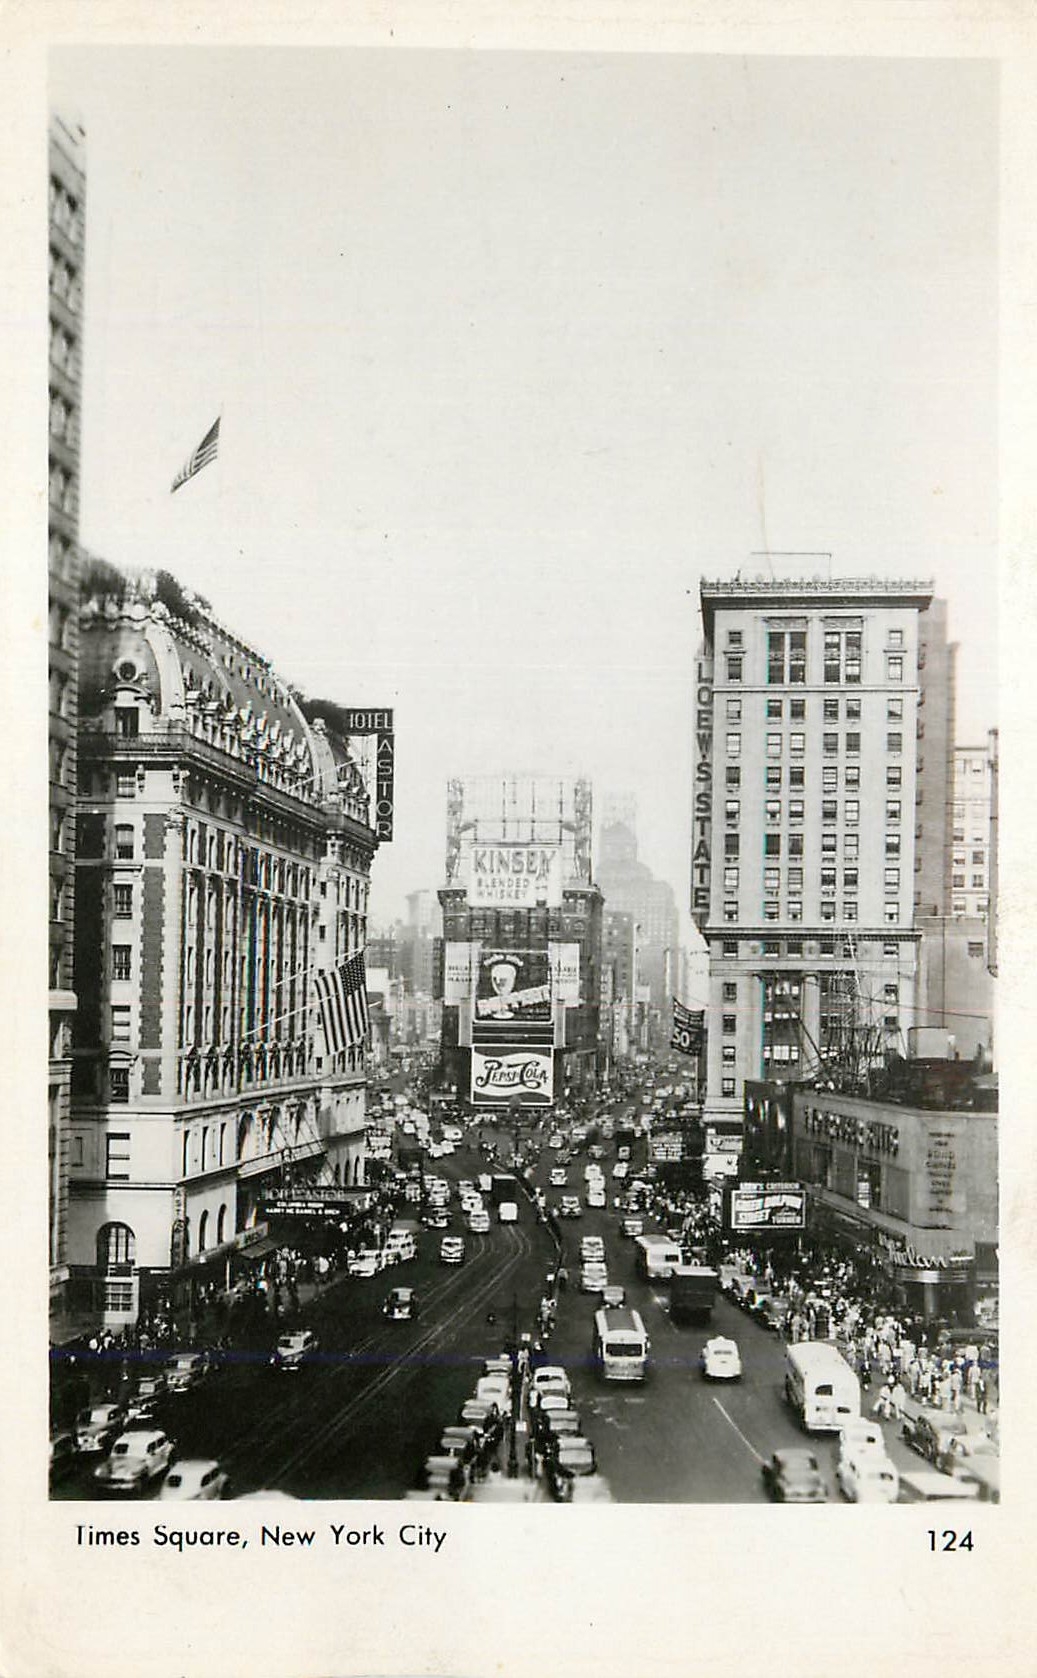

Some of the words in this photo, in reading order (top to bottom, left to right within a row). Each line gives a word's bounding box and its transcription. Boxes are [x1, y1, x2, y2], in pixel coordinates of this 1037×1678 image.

[696, 662, 713, 782] LOEW'S
[376, 739, 393, 837] ASTOR
[474, 850, 556, 873] KINSEY
[693, 792, 711, 910] STATE
